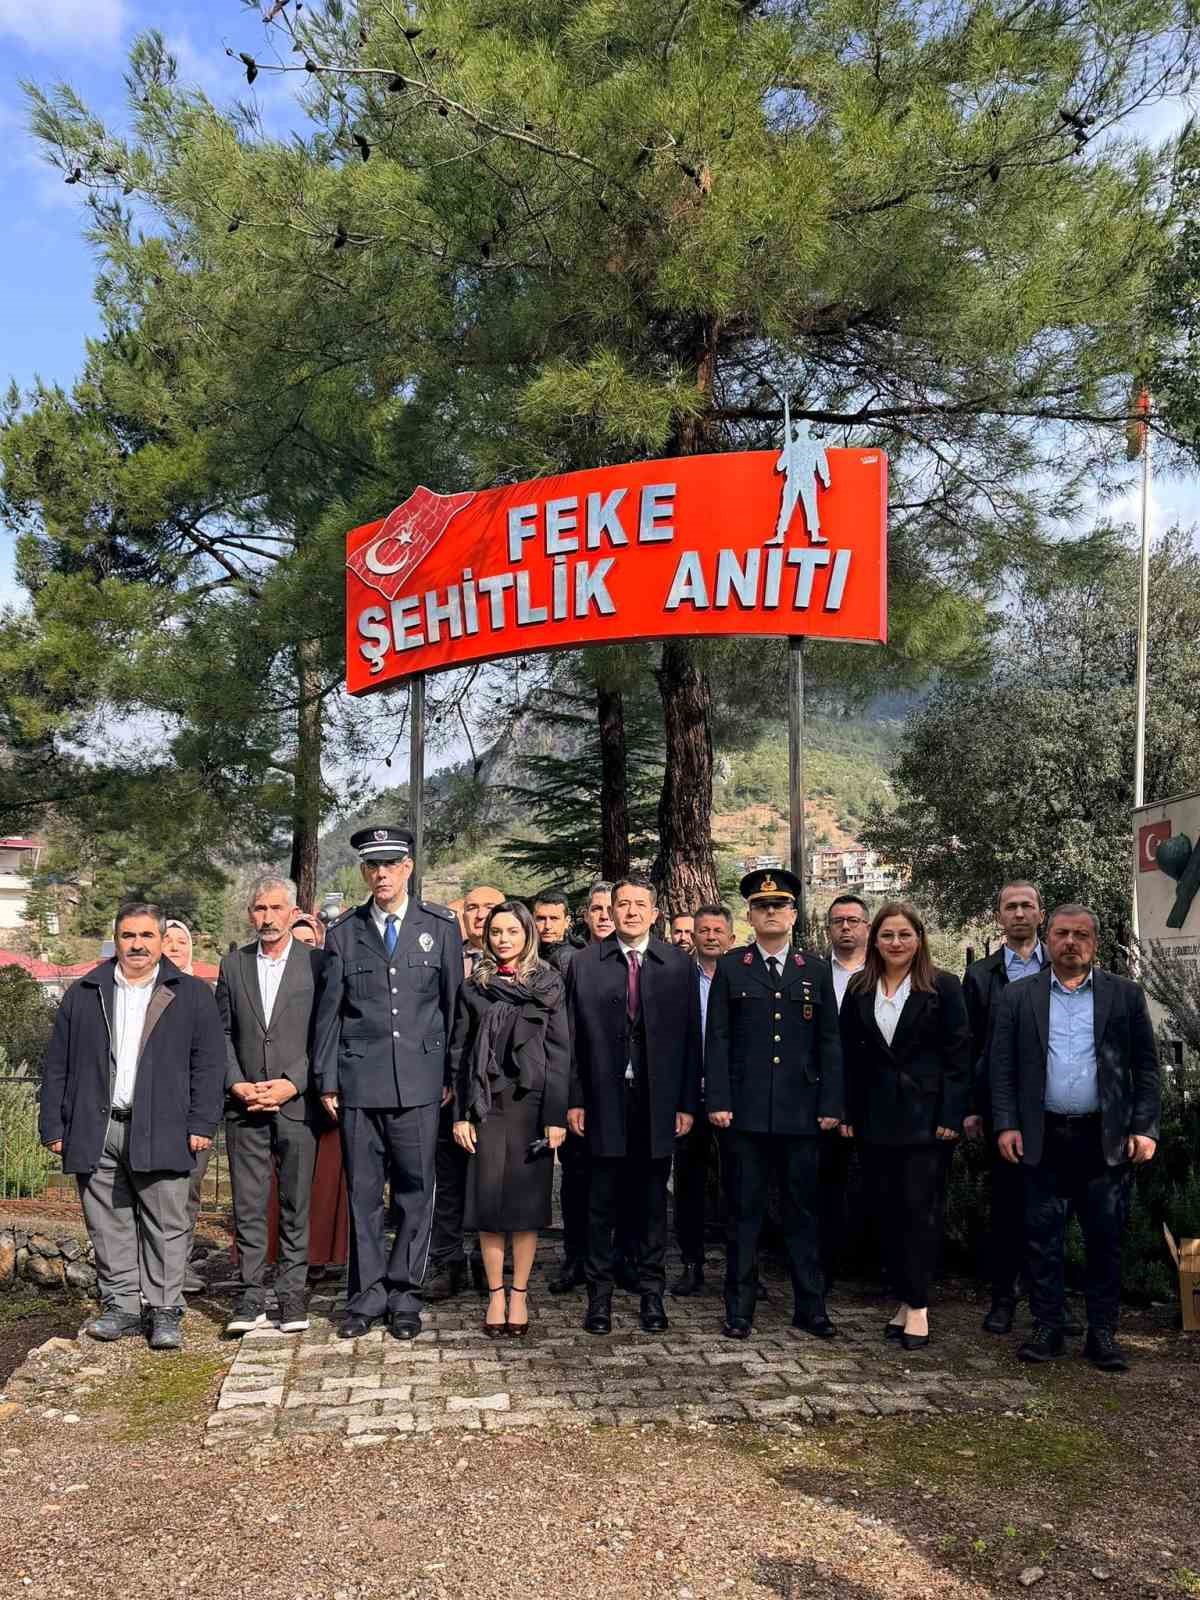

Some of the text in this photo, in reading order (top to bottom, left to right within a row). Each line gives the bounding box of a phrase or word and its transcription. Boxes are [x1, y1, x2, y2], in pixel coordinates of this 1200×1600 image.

[508, 483, 677, 562] FEKE
[358, 547, 852, 673] ŞEHİTLİK ANITI
